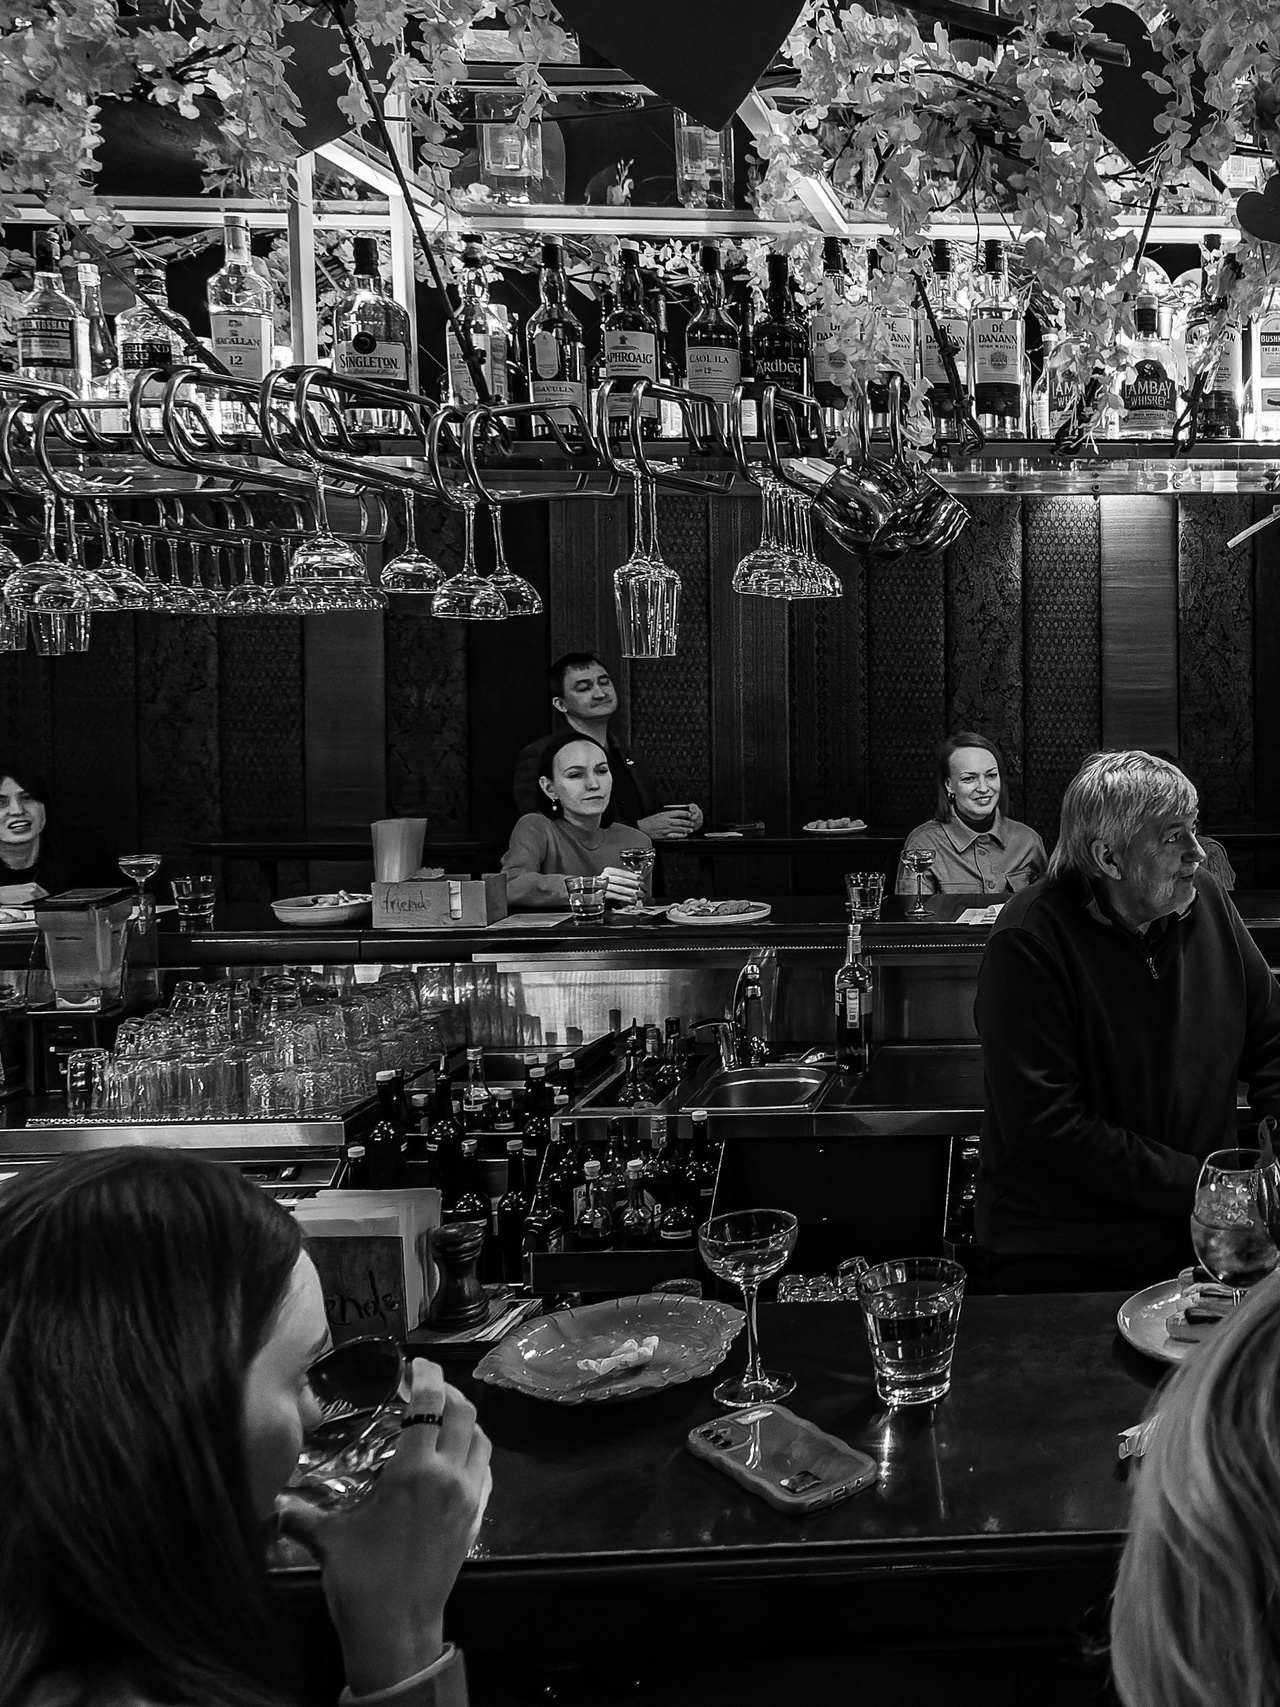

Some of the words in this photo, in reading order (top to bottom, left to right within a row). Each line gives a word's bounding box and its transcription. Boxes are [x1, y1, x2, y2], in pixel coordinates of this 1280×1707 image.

[978, 334, 1017, 345] DANANN
[229, 356, 244, 365] 12
[689, 354, 711, 363] CAOL
[1124, 380, 1172, 399] LAMBAY
[1131, 395, 1166, 406] WHISKEY
